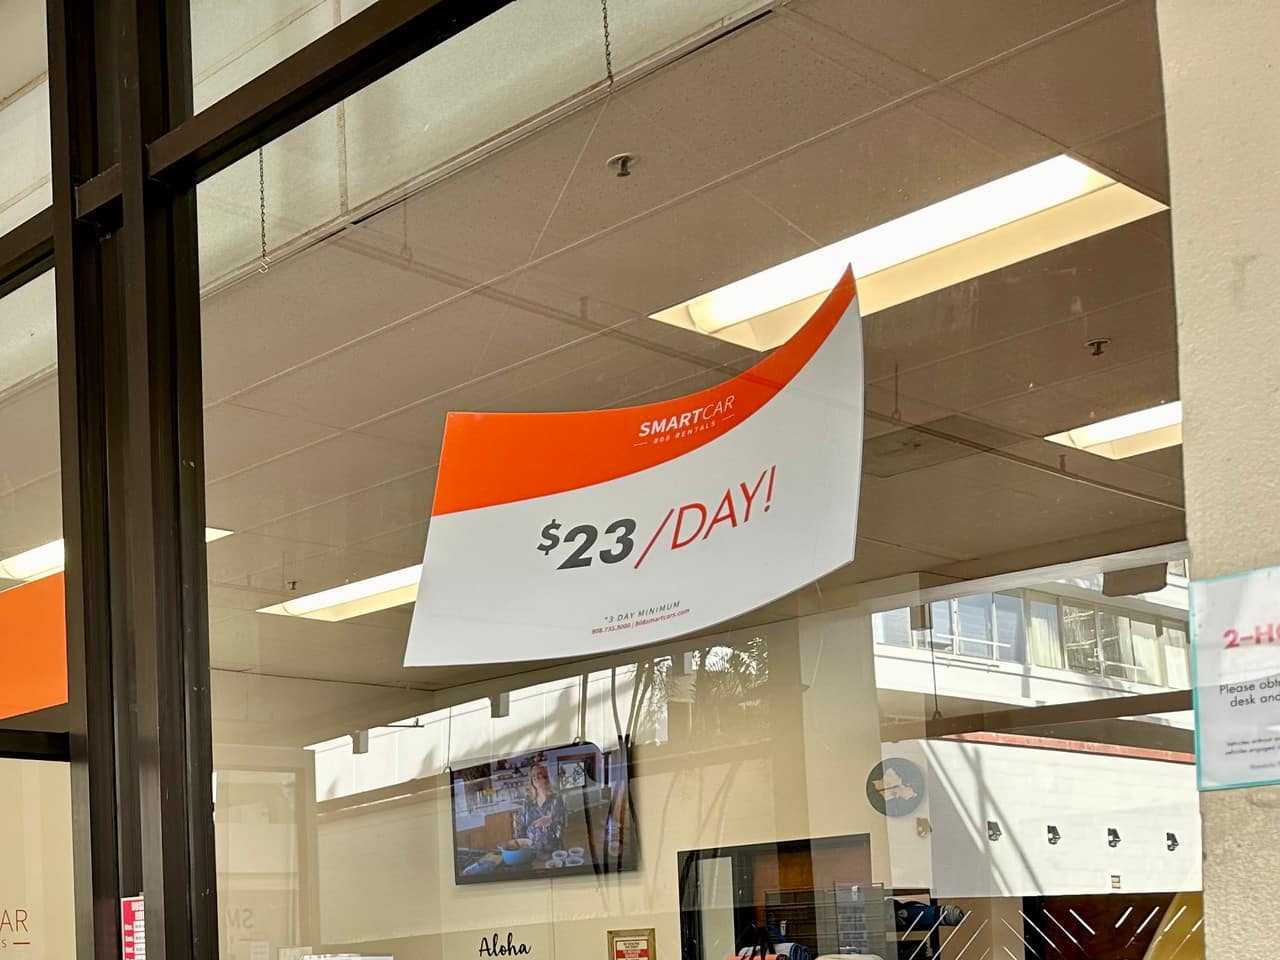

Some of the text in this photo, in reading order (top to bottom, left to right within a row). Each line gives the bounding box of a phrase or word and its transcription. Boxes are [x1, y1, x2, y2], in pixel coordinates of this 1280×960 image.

[639, 395, 735, 437] SMARTCAR
[675, 420, 716, 439] RENTALS
[617, 612, 635, 622] DAY
[637, 600, 680, 617] MINIMUM
[1224, 624, 1280, 649] 2-H
[1220, 677, 1280, 695] Please obt
[1230, 695, 1255, 707] desk
[479, 932, 532, 958] Aloha
